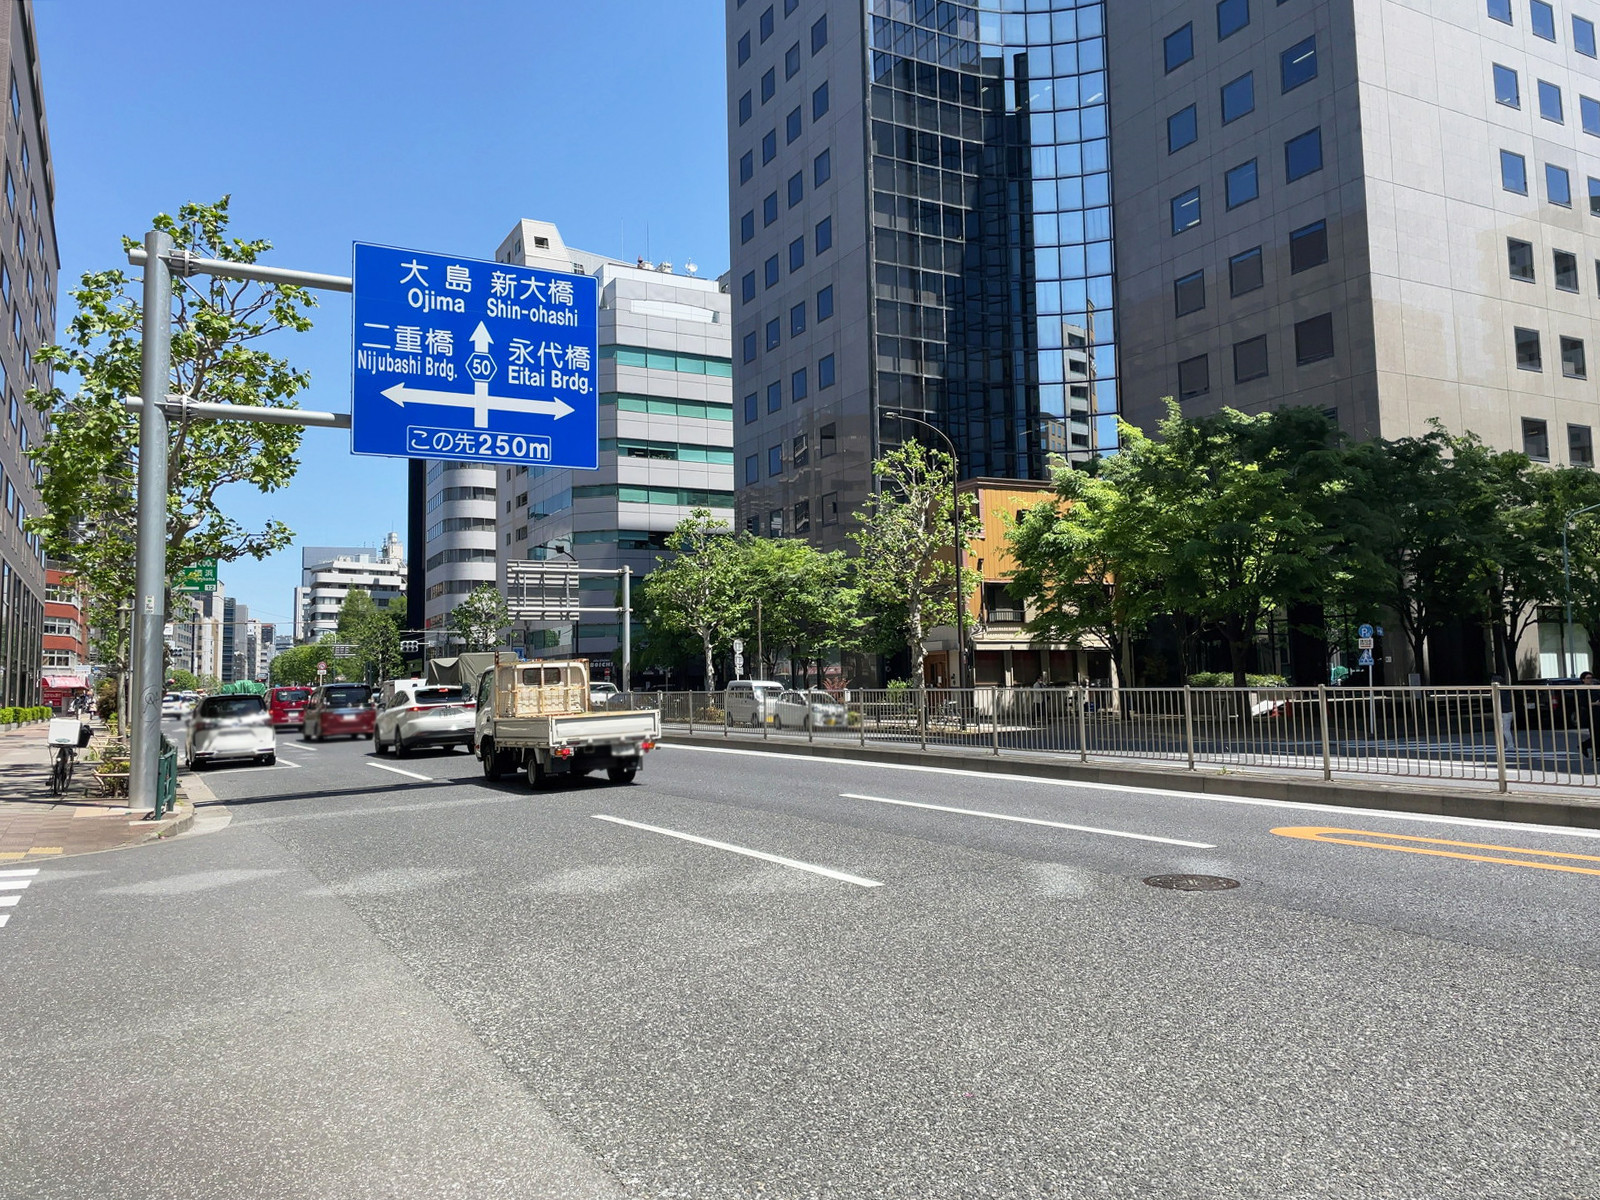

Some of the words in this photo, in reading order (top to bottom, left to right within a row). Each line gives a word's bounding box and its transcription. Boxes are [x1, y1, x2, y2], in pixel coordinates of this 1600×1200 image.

[399, 259, 473, 294] 大島
[490, 270, 575, 307] 新大橋
[408, 287, 466, 313] Ojima
[486, 297, 579, 328] Shin-ohashi
[362, 322, 454, 357] 二重橋
[508, 338, 592, 372] 永代橋
[357, 349, 422, 376] Nijubashi
[425, 357, 458, 382] Brdg.
[472, 358, 491, 375] 50
[508, 365, 545, 387] Eitai
[551, 370, 593, 395] Brdg.
[410, 430, 549, 459] この先250m
